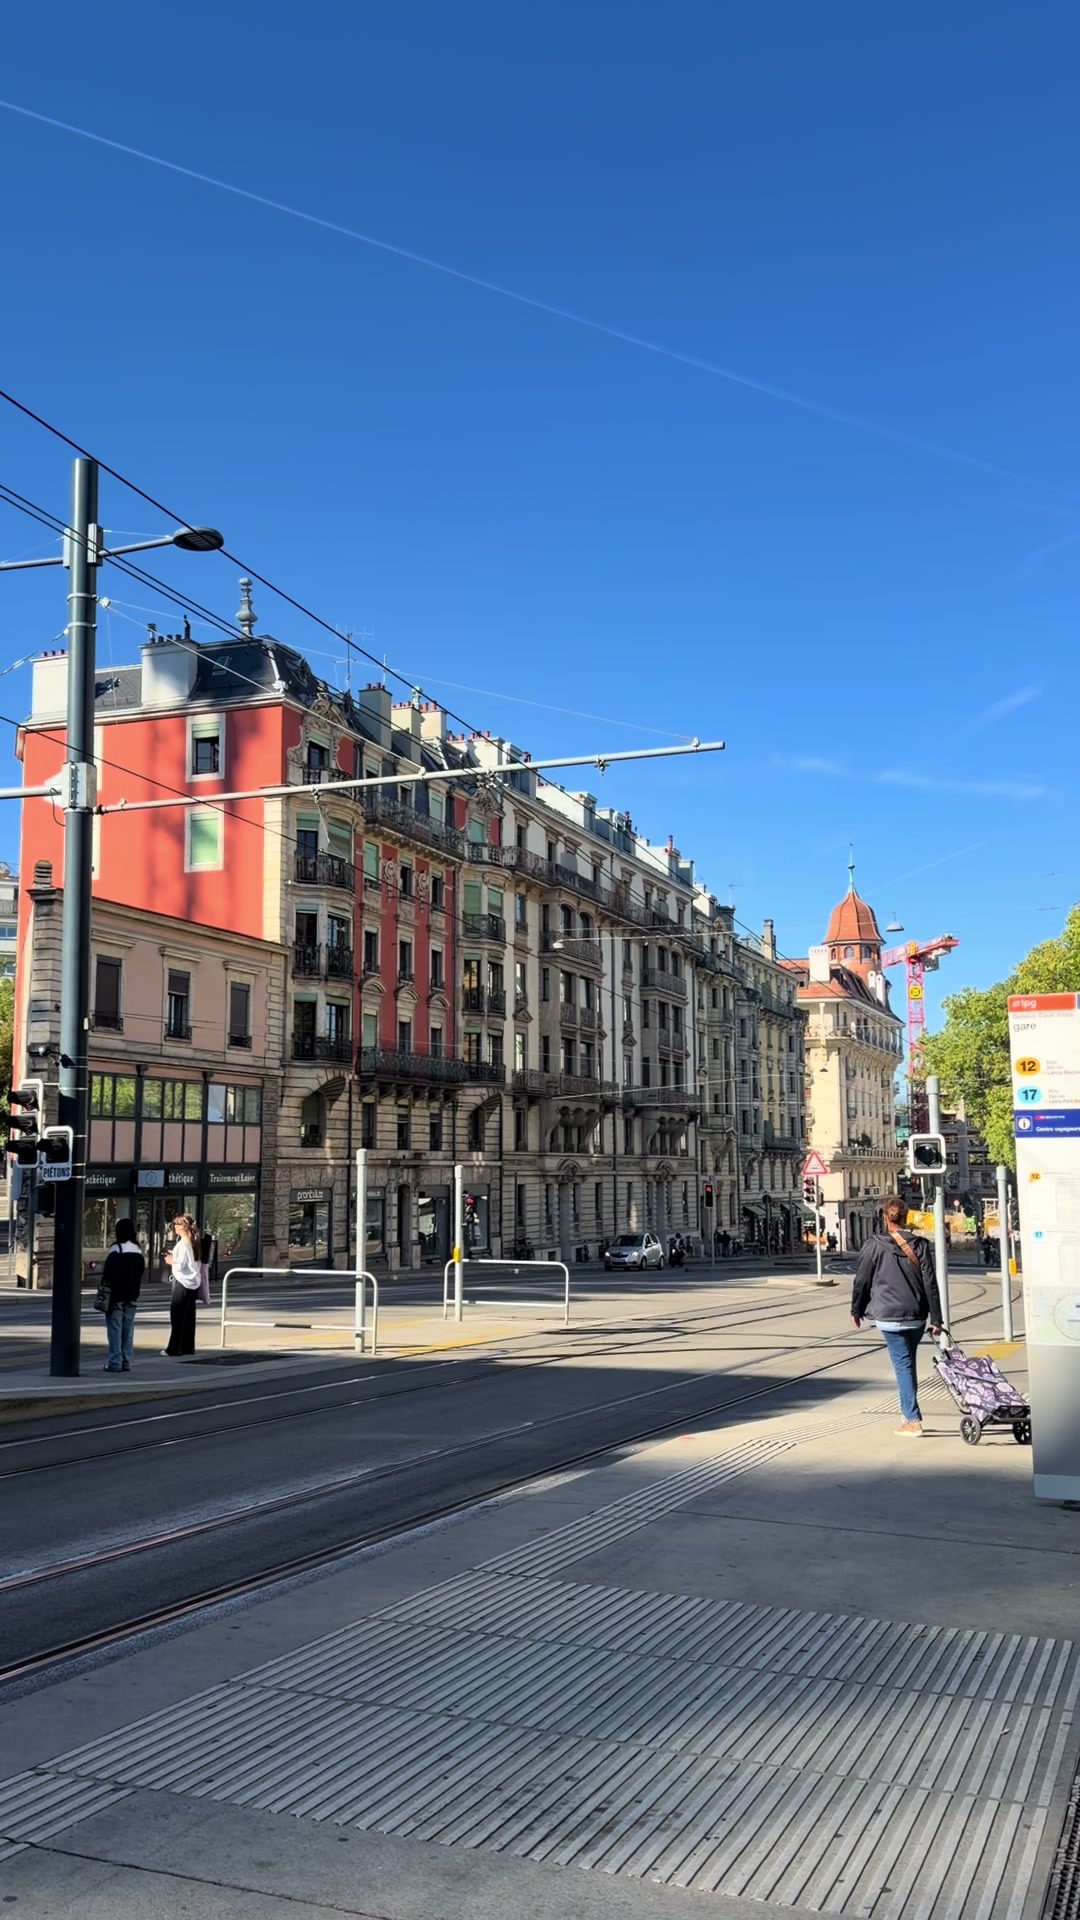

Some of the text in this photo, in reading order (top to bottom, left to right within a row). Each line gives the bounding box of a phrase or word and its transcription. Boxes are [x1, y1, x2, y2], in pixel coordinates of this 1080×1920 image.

[1021, 1000, 1037, 1009] tpg
[1013, 1023, 1037, 1032] gare
[1020, 1061, 1036, 1071] 12
[1022, 1089, 1037, 1100] 17
[43, 1167, 71, 1178] PIÉTONS
[168, 1173, 194, 1186] thétique
[210, 1173, 239, 1183] Traitement
